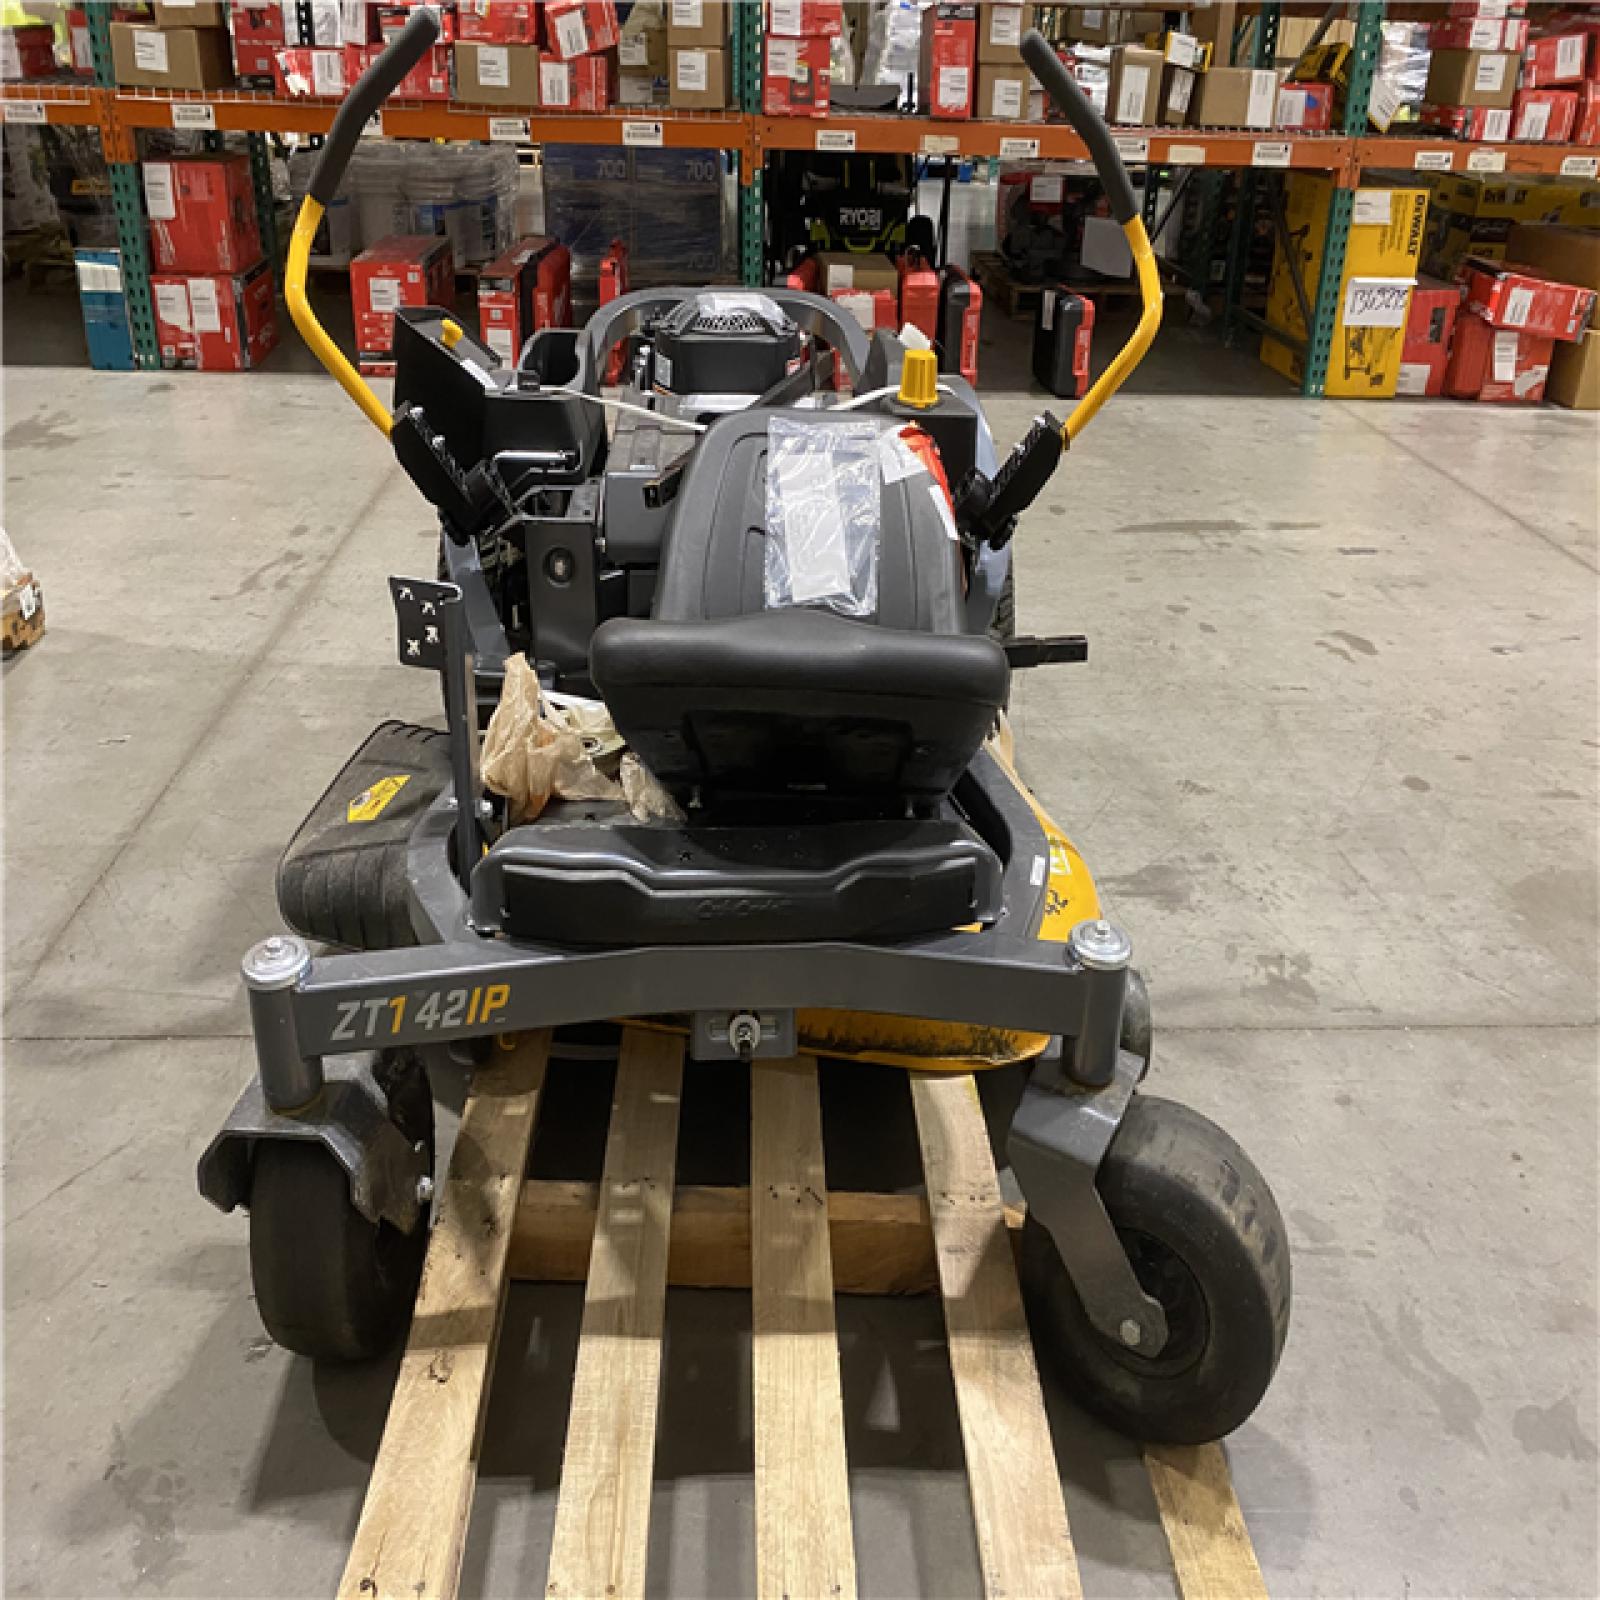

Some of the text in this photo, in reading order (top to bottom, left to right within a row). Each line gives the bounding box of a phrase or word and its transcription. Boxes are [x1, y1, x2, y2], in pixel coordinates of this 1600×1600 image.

[597, 160, 626, 178] 700
[685, 160, 716, 180] 700
[330, 995, 408, 1041] ZT1
